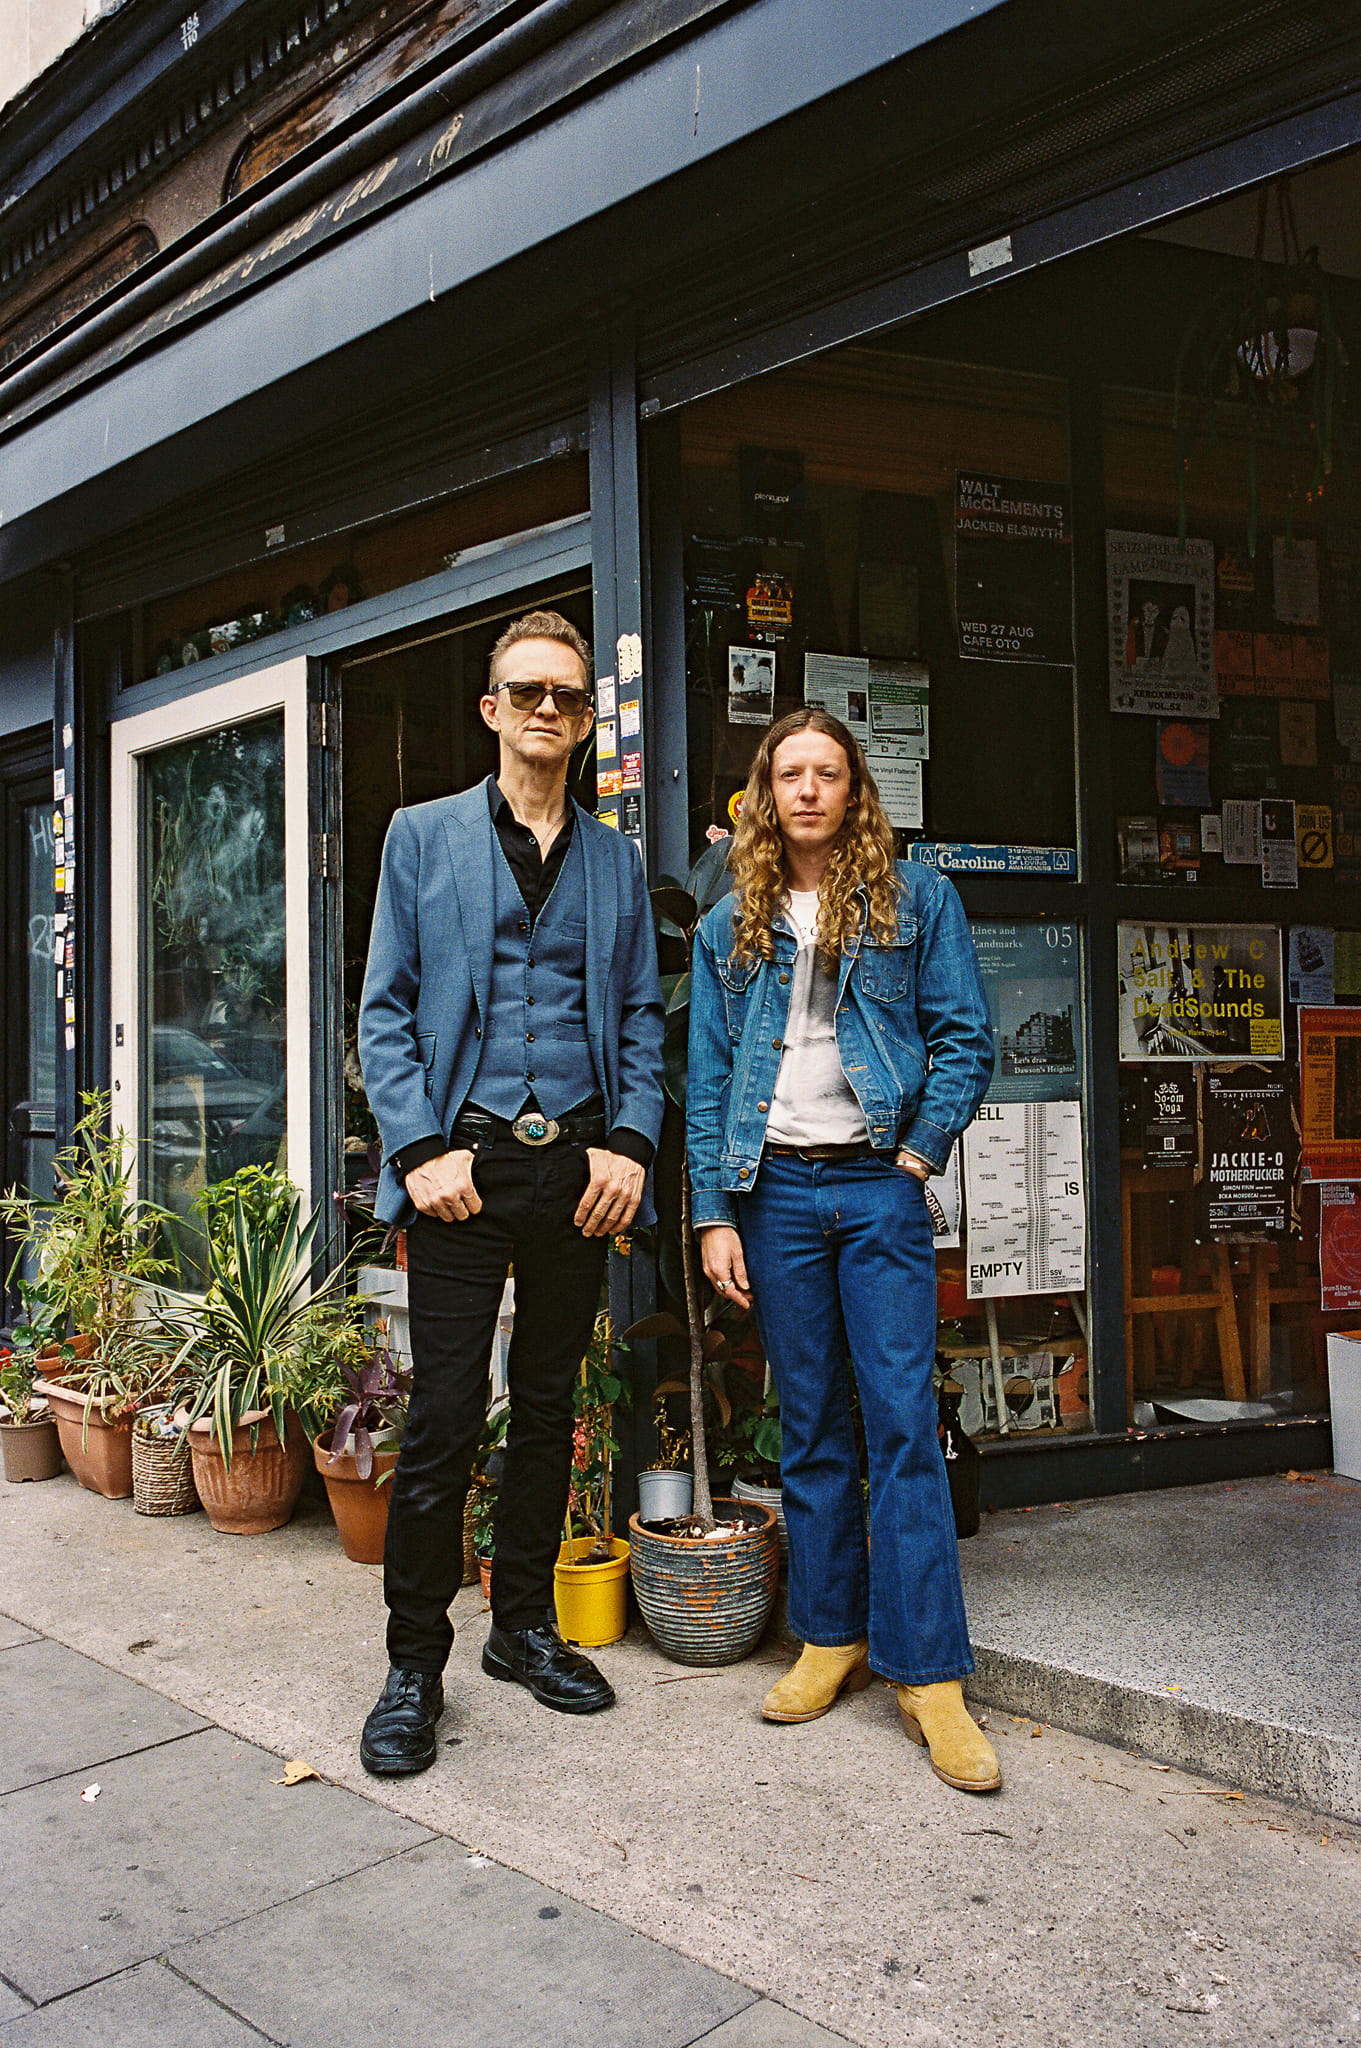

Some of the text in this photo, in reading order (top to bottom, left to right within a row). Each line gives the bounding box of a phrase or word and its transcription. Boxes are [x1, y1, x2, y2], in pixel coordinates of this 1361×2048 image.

[183, 30, 198, 51] 110
[960, 480, 1001, 498] WALT
[960, 495, 1064, 519] McCLEMENTS
[957, 518, 1064, 539] JACKEN ELSWYTH
[961, 621, 1034, 639] WED 27 AUG
[962, 635, 1021, 650] CAFE OTO
[880, 767, 893, 775] Vinyl
[1298, 815, 1330, 829] JOIN US
[937, 852, 1007, 870] Caroline
[971, 926, 1016, 935] Lines and
[1046, 925, 1073, 948] 05
[973, 939, 1023, 949] Landmarks
[1132, 938, 1265, 960] Andrew C
[1133, 967, 1265, 989] Salt & The
[1134, 997, 1265, 1018] DeadSounds
[1014, 1056, 1048, 1064] Let's draw
[1014, 1064, 1075, 1075] Dawson's Heights!
[1240, 1091, 1281, 1099] RESIDENCY
[1158, 1103, 1182, 1116] Yoga
[1210, 1152, 1284, 1169] JACKIE-O
[1210, 1168, 1285, 1183] MOTHERFUCKER
[1065, 1181, 1080, 1196] IS
[1233, 1192, 1260, 1200] MORDECAI
[925, 1188, 950, 1234] PORTAL
[970, 1261, 1023, 1278] EMPTY
